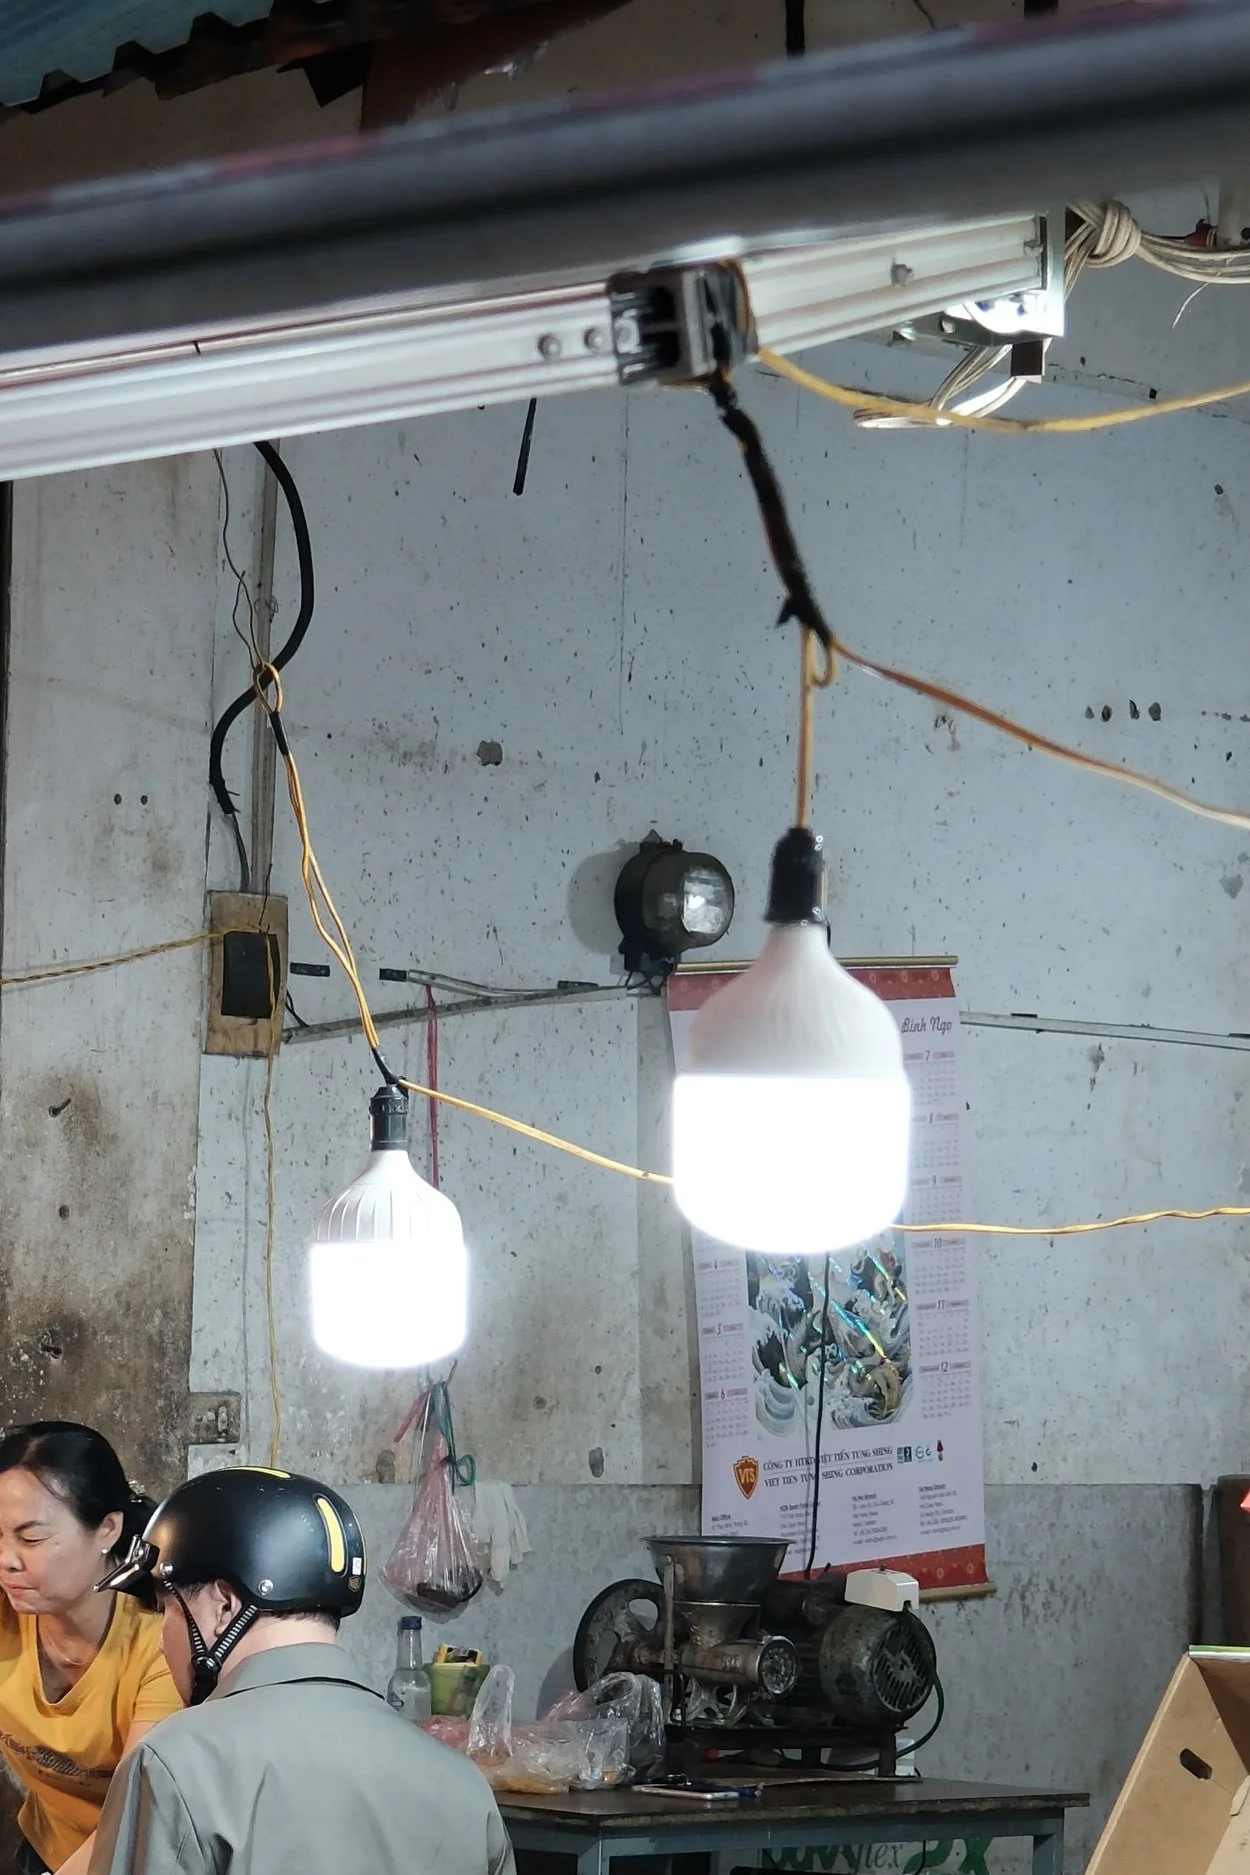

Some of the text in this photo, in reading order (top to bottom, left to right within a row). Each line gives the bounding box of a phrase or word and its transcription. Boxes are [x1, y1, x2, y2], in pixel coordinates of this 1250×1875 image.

[940, 1361, 949, 1373] 12
[738, 1468, 755, 1485] VTS
[845, 1463, 894, 1477] CORPORATION
